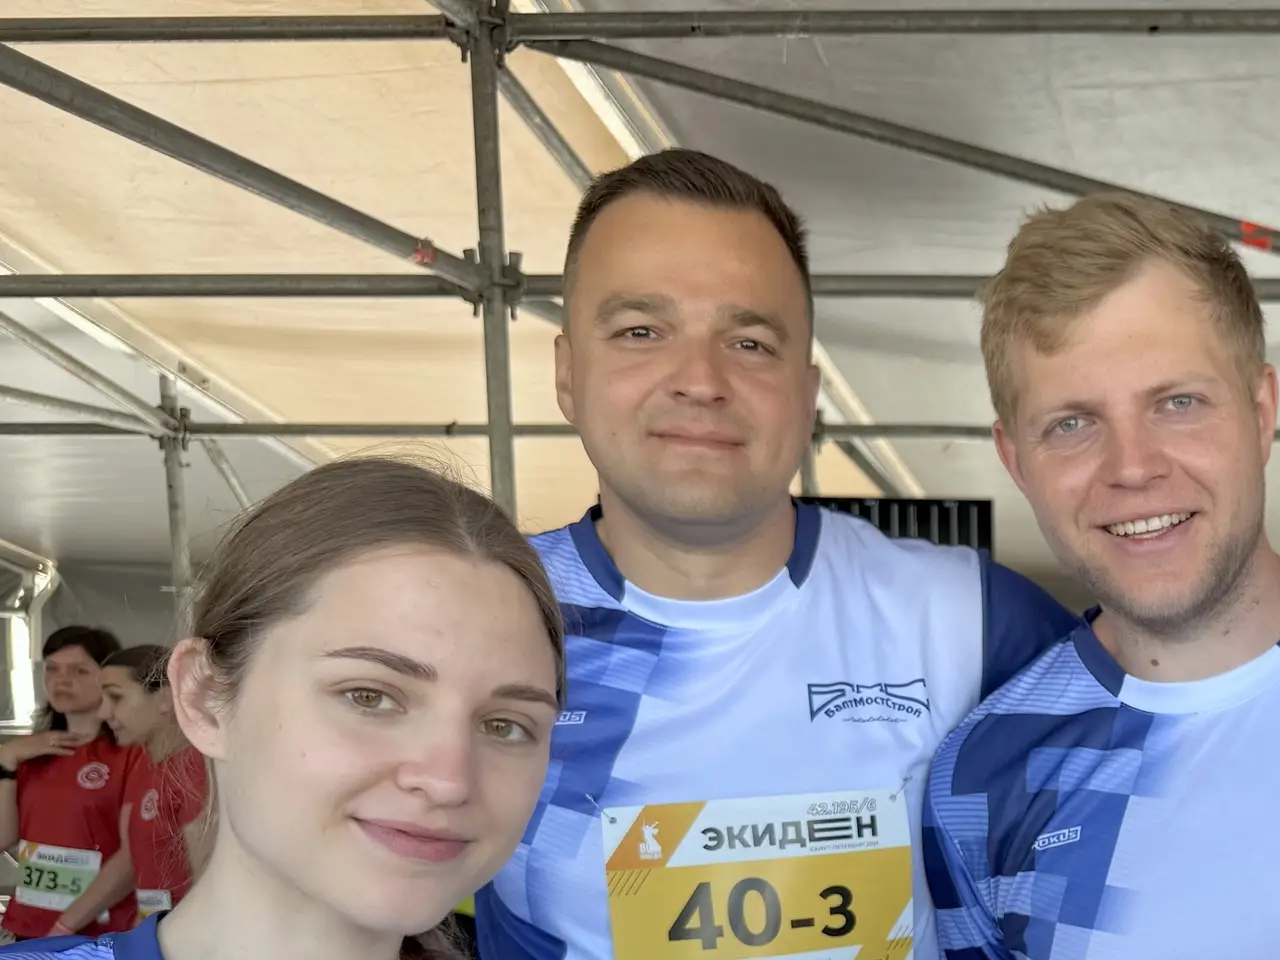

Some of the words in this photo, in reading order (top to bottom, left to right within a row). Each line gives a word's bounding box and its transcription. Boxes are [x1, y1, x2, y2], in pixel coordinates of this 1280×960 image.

[824, 695, 923, 719] БалтМостСтрой
[806, 796, 877, 816] 42.195/6
[700, 814, 879, 852] ЭКИДЕН
[23, 866, 82, 895] 373-5
[667, 876, 858, 951] 40-3
